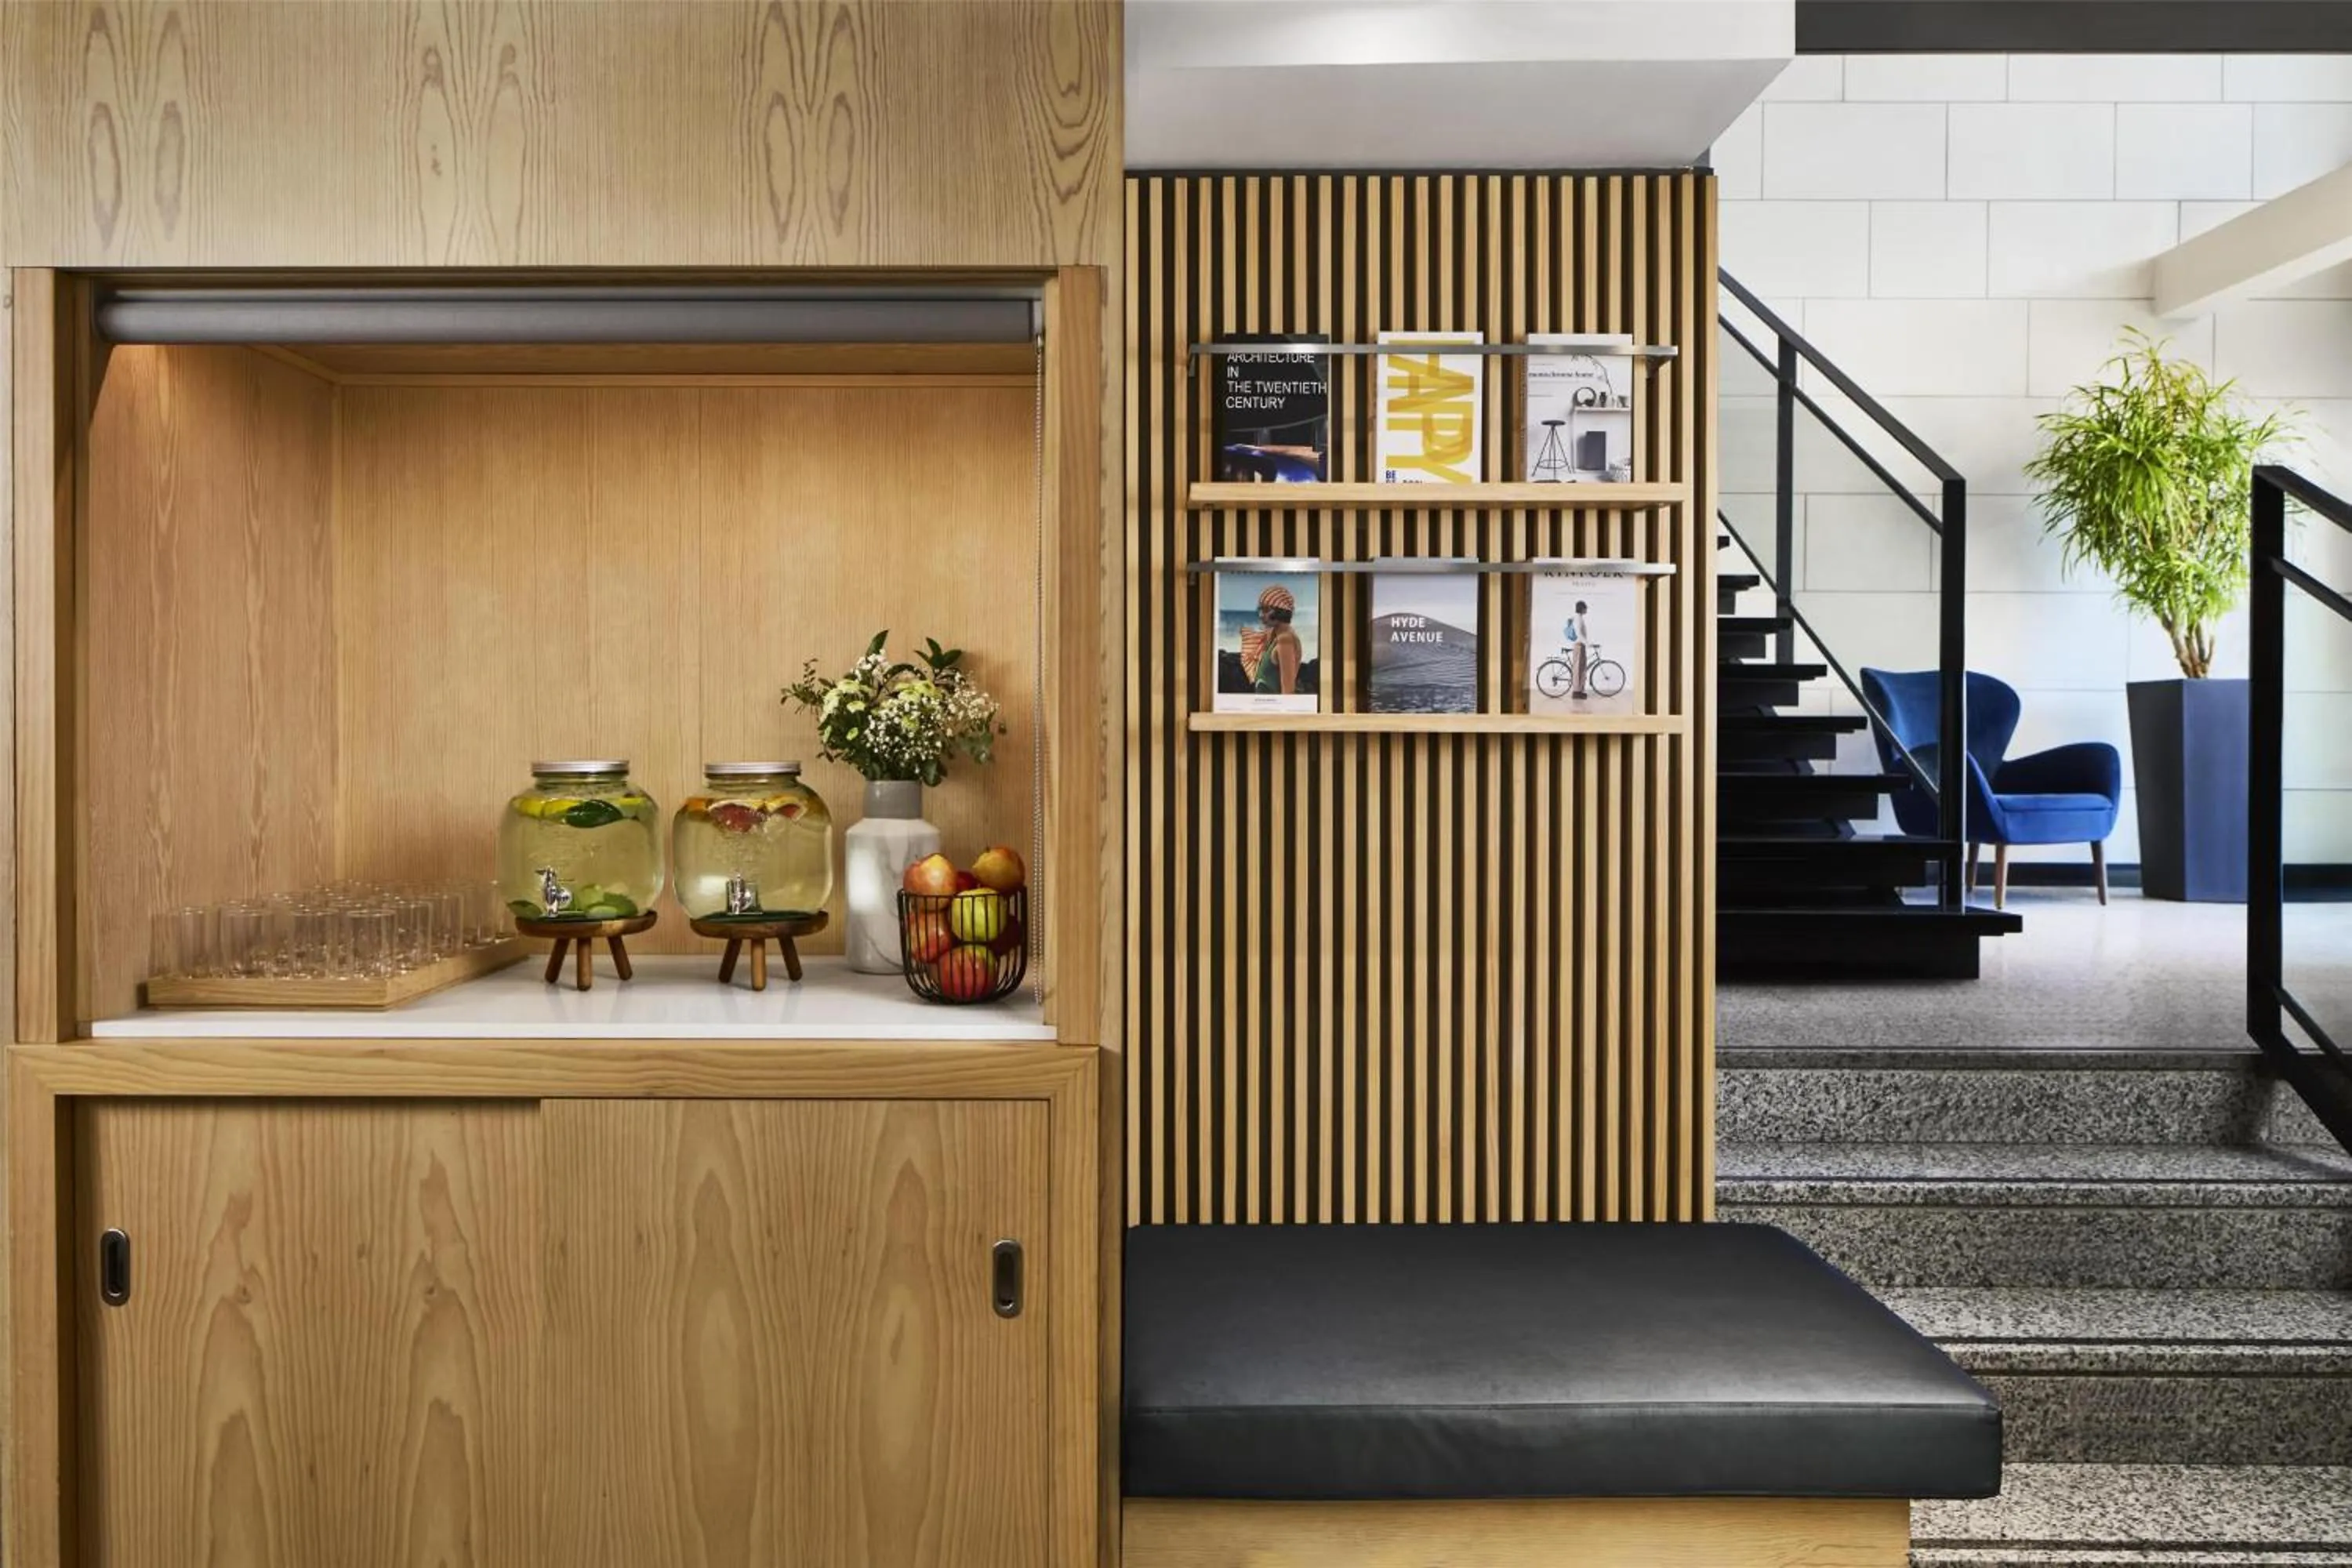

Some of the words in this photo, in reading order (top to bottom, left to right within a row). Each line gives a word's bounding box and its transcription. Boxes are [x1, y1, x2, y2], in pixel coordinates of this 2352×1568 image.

[1227, 353, 1315, 363] ARCHITECTURE
[1227, 366, 1240, 378] IN
[1227, 380, 1252, 393] THE
[1256, 381, 1327, 394] TWENTIETH
[1225, 396, 1286, 408] CENTURY
[1391, 617, 1426, 628] HYDE
[1390, 631, 1443, 643] AVENUE
